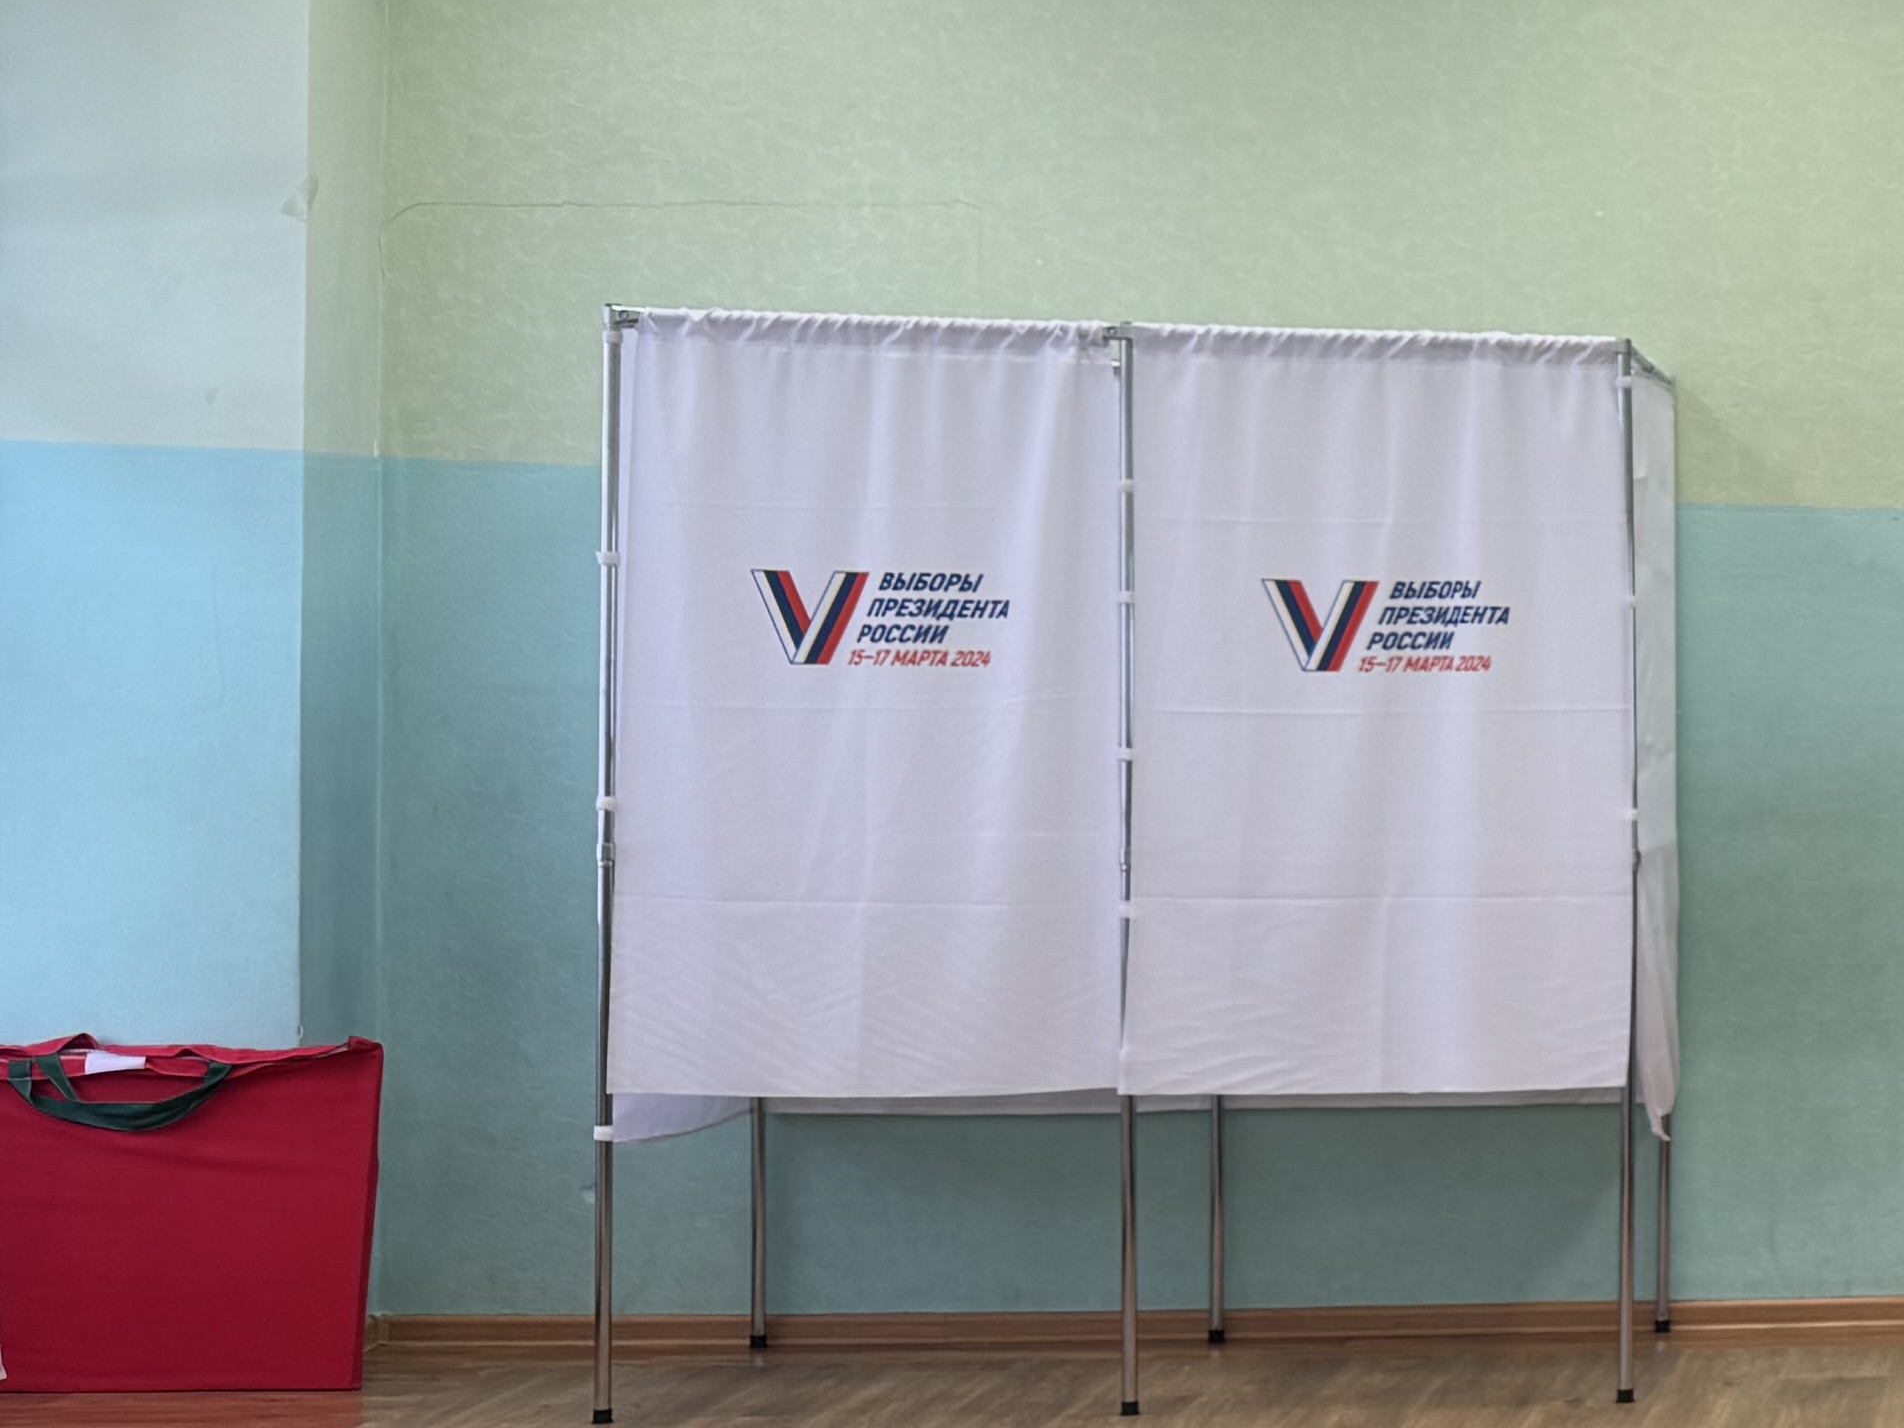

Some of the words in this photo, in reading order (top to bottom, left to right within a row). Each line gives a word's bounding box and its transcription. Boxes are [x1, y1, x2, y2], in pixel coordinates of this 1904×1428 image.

[879, 572, 983, 593] ВЫБОРЫ
[1389, 580, 1481, 600] ВЫБОРЫ
[867, 598, 1010, 621] ПРЕЗИДЕНТА
[1378, 606, 1511, 628] ПРЕЗИДЕНТА
[857, 624, 949, 644] РОССИИ
[1366, 631, 1455, 651] РОССИИ
[891, 650, 949, 666] МАРТА
[951, 651, 991, 667] 2024
[1404, 656, 1454, 672] МАРТА
[1455, 655, 1492, 672] 2024
